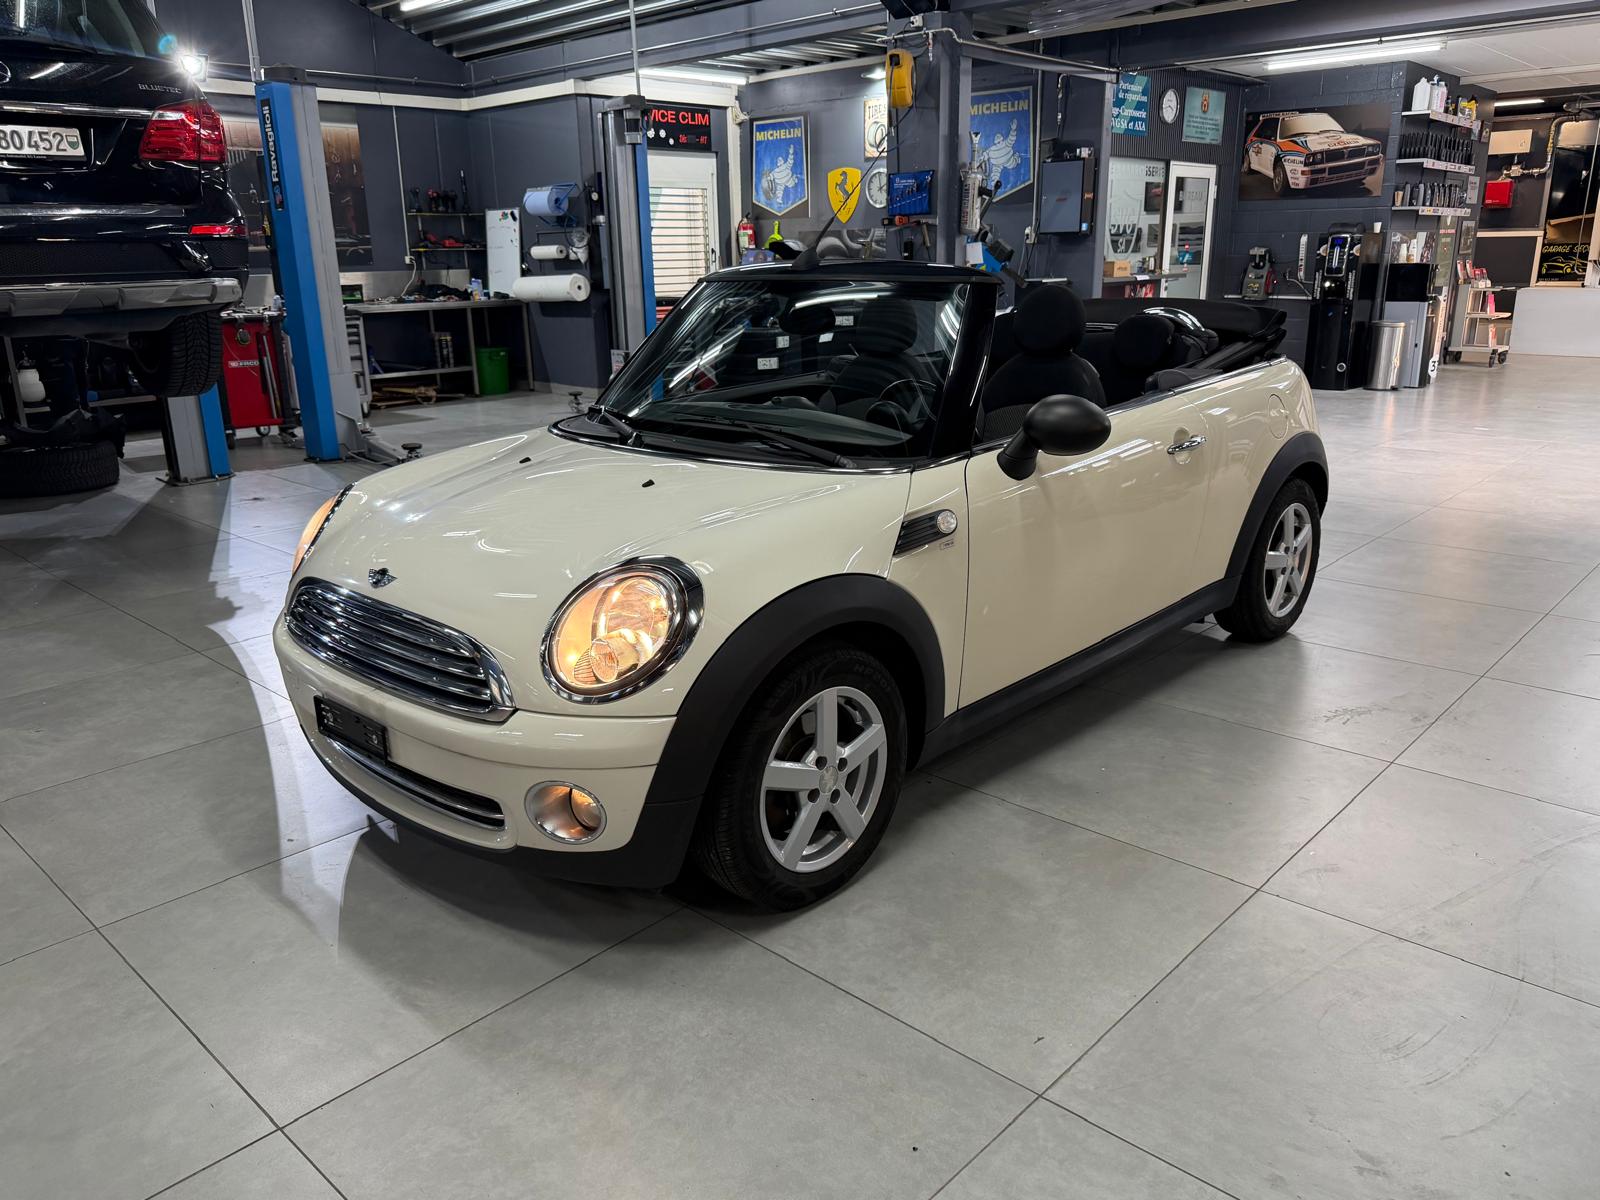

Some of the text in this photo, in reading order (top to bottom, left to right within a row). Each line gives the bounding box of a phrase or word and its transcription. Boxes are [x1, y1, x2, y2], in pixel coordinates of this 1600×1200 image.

[138, 83, 182, 94] BLUETEC
[970, 99, 1029, 115] MICHELIN
[679, 112, 710, 126] CLIM
[756, 127, 801, 142] MICHELIN
[262, 105, 279, 182] Ravaglioli
